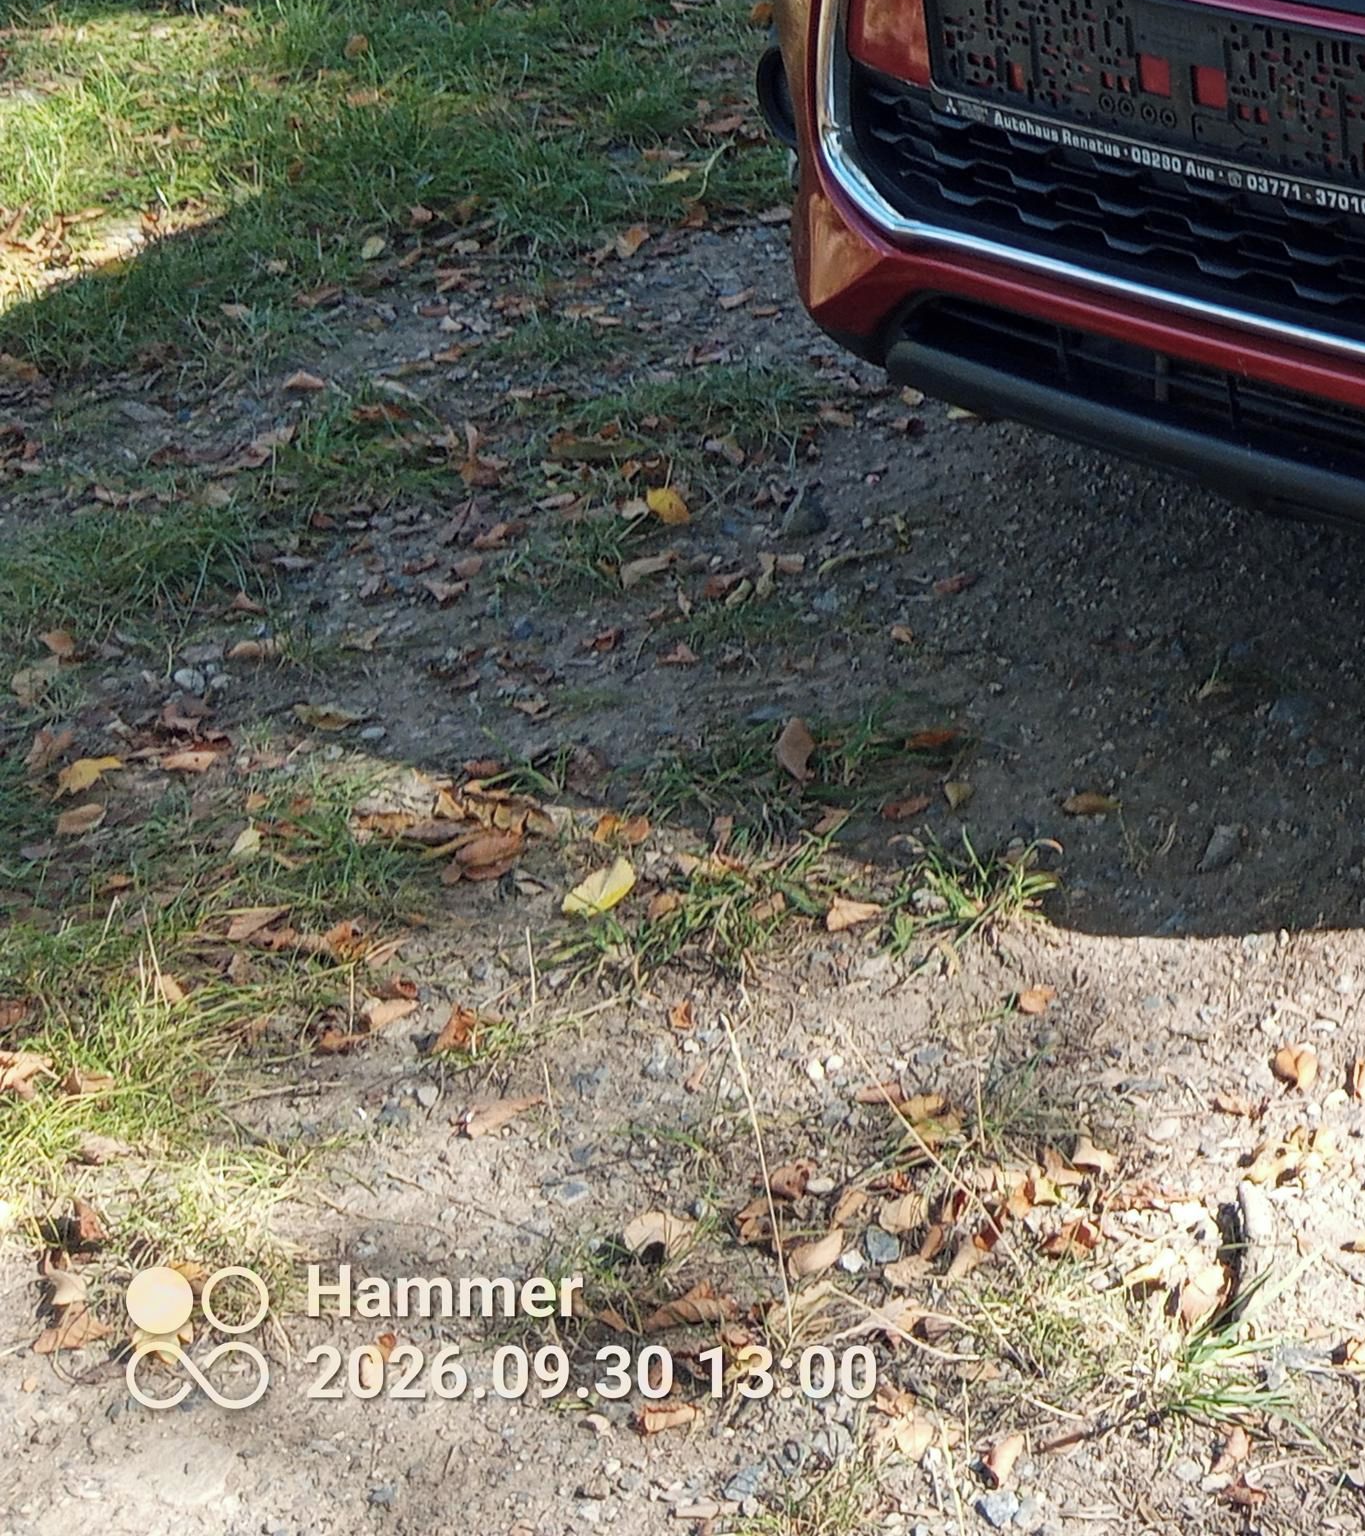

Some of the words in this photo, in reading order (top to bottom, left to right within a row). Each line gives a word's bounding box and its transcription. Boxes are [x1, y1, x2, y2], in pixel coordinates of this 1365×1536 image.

[993, 110, 1060, 143] Autohaus
[1062, 128, 1121, 159] Renatus
[1185, 161, 1215, 182] Aue
[1246, 175, 1301, 201] 03771
